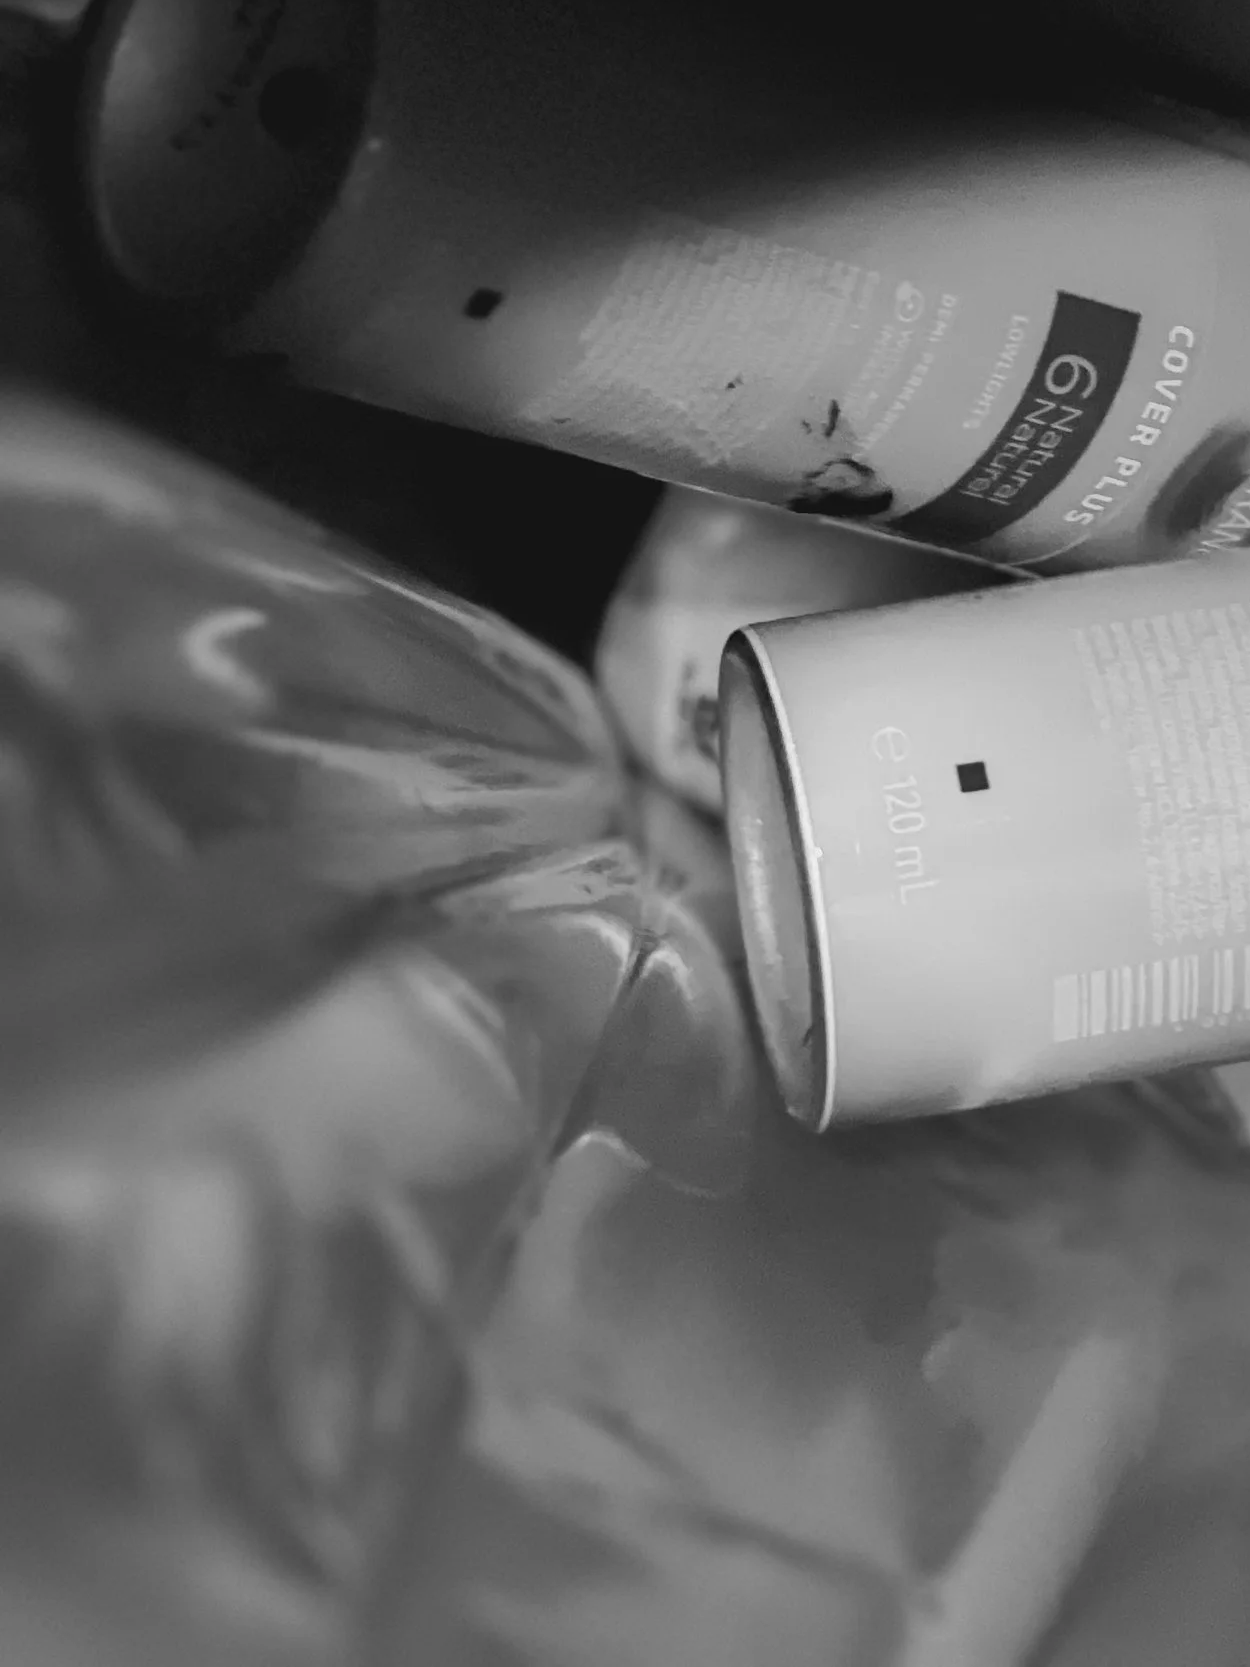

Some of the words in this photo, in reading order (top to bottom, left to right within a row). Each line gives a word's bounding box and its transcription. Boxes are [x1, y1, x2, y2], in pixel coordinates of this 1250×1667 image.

[1046, 356, 1096, 398] 6
[1132, 323, 1193, 445] COVER
[984, 404, 1082, 505] Natural
[1064, 456, 1142, 524] PLUS
[881, 774, 927, 834] 120
